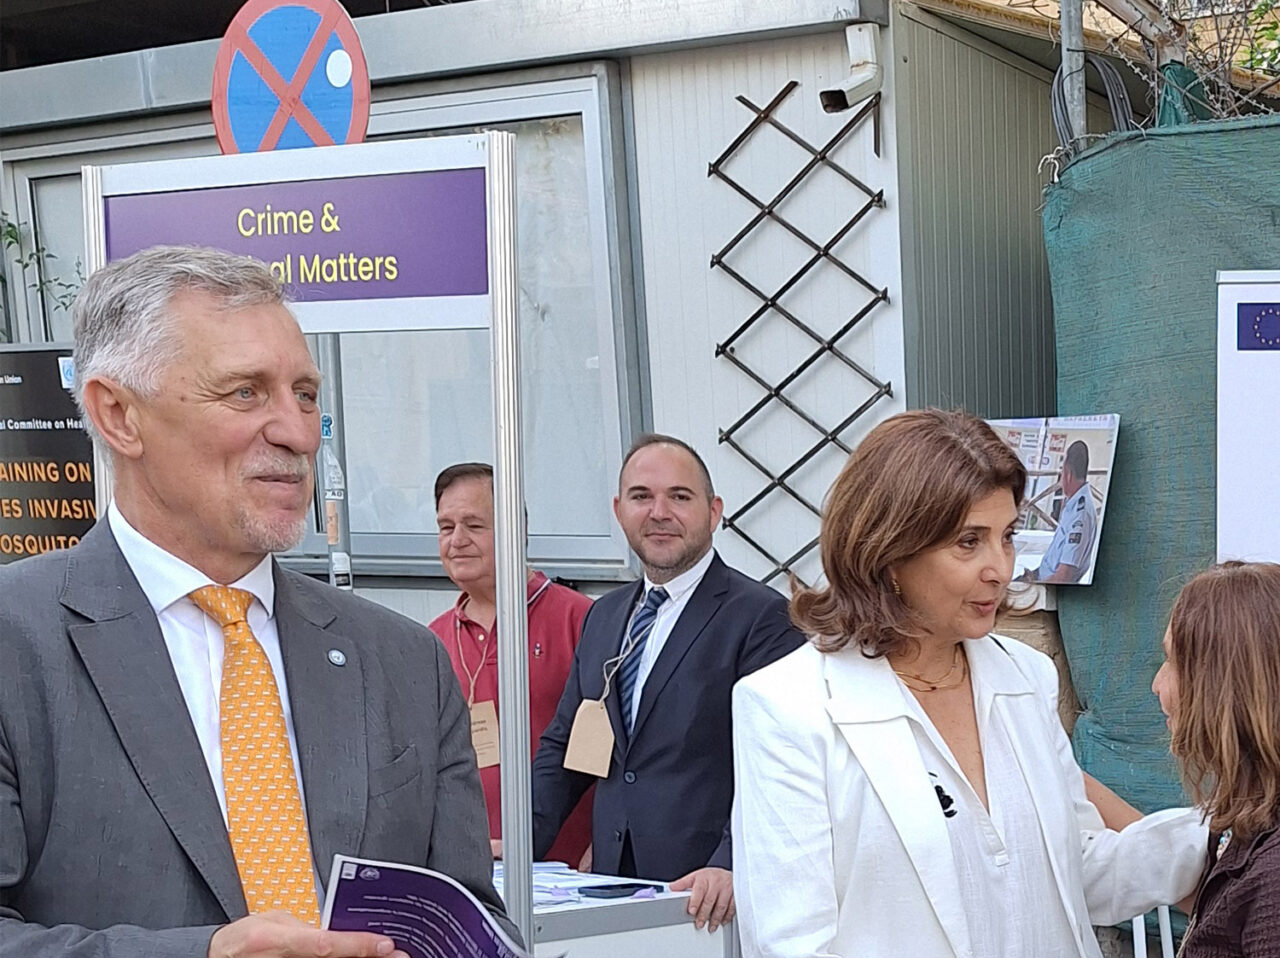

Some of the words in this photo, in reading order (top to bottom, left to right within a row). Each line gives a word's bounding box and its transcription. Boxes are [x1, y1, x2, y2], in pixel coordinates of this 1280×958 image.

[237, 204, 314, 237] Crime
[320, 202, 341, 233] &
[299, 253, 398, 284] Matters
[7, 418, 52, 430] Committee
[54, 420, 65, 430] on
[0, 462, 60, 482] AINING
[64, 462, 92, 482] ON
